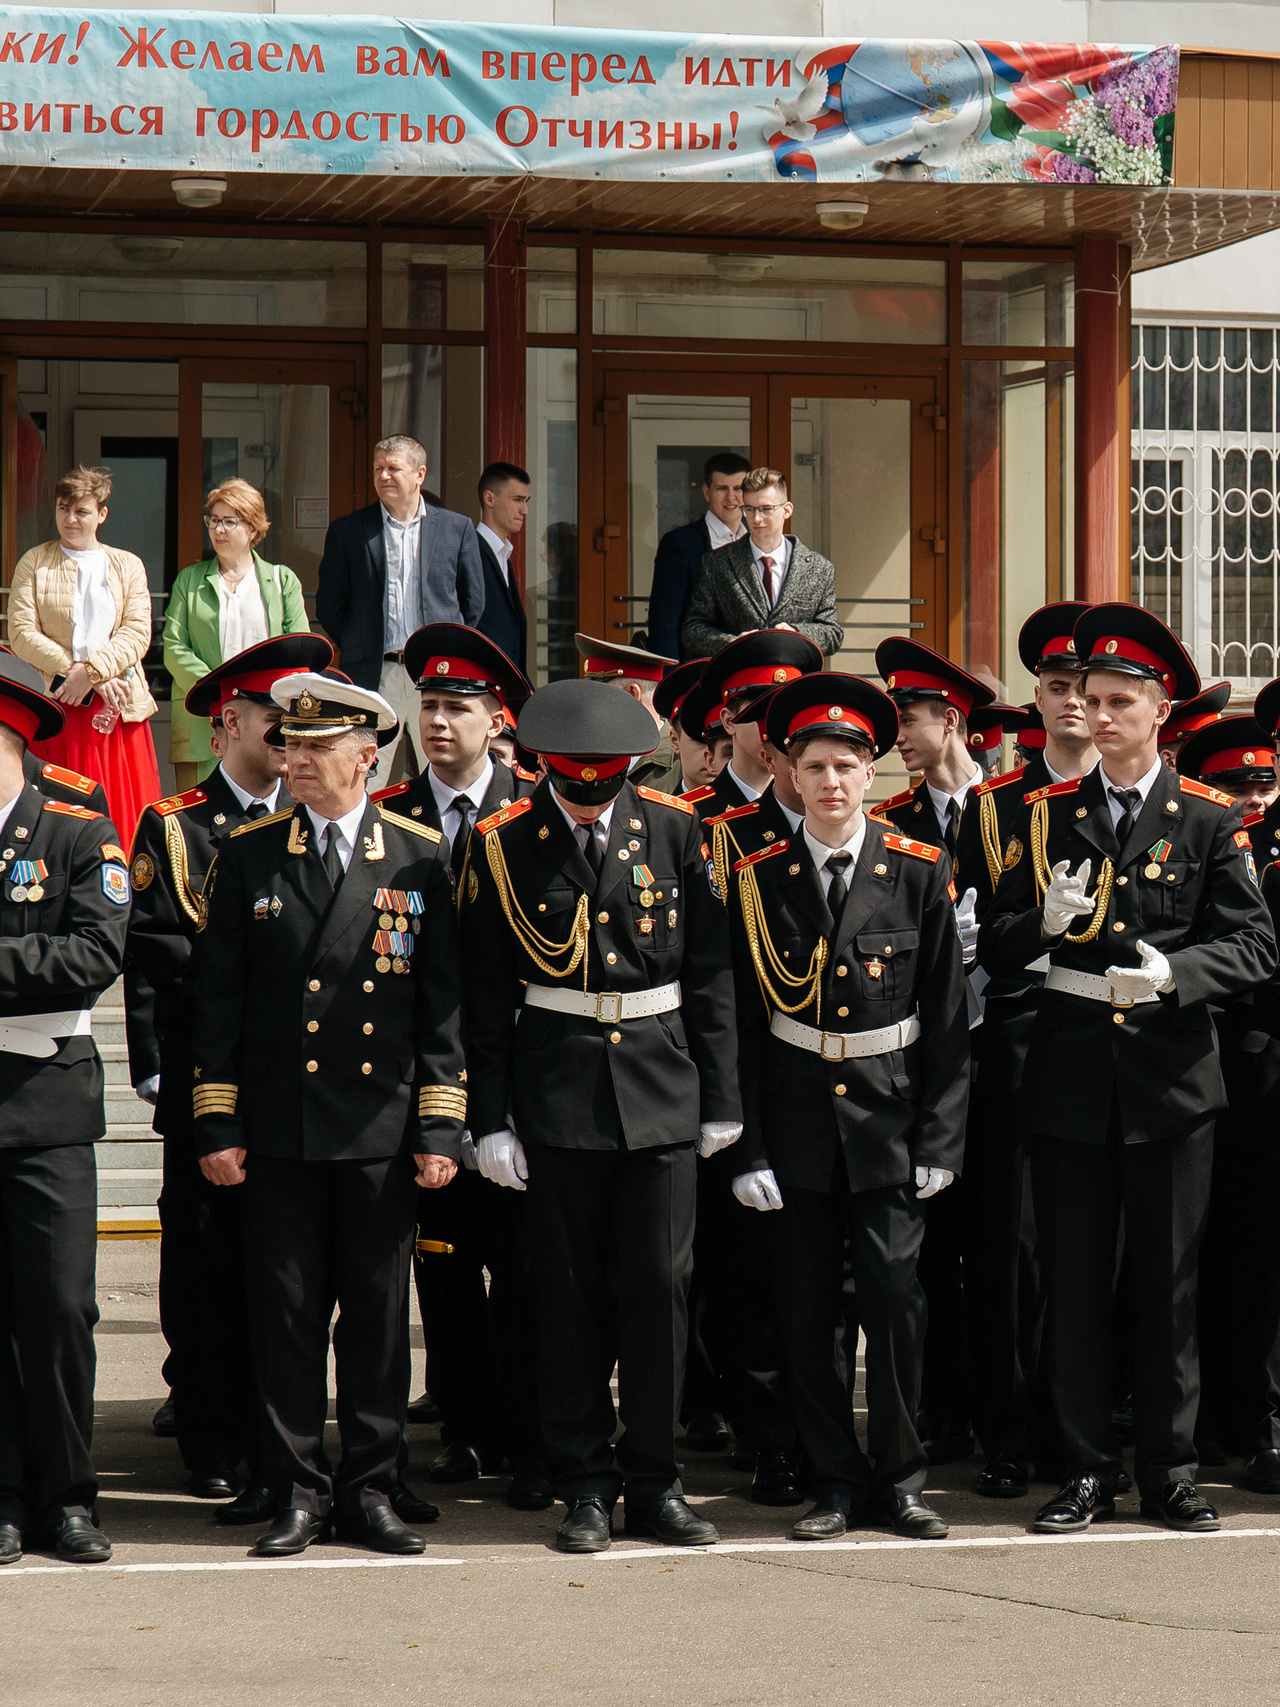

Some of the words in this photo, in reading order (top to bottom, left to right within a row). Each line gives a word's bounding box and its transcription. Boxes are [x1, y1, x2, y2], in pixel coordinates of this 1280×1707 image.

[0, 21, 91, 65] ки!
[117, 27, 325, 73] Желаем
[357, 46, 451, 78] вам
[482, 51, 656, 97] вперед
[684, 57, 792, 88] идти
[0, 102, 163, 136] виться
[196, 107, 466, 153] гордостью
[495, 105, 739, 150] Отчизны!
